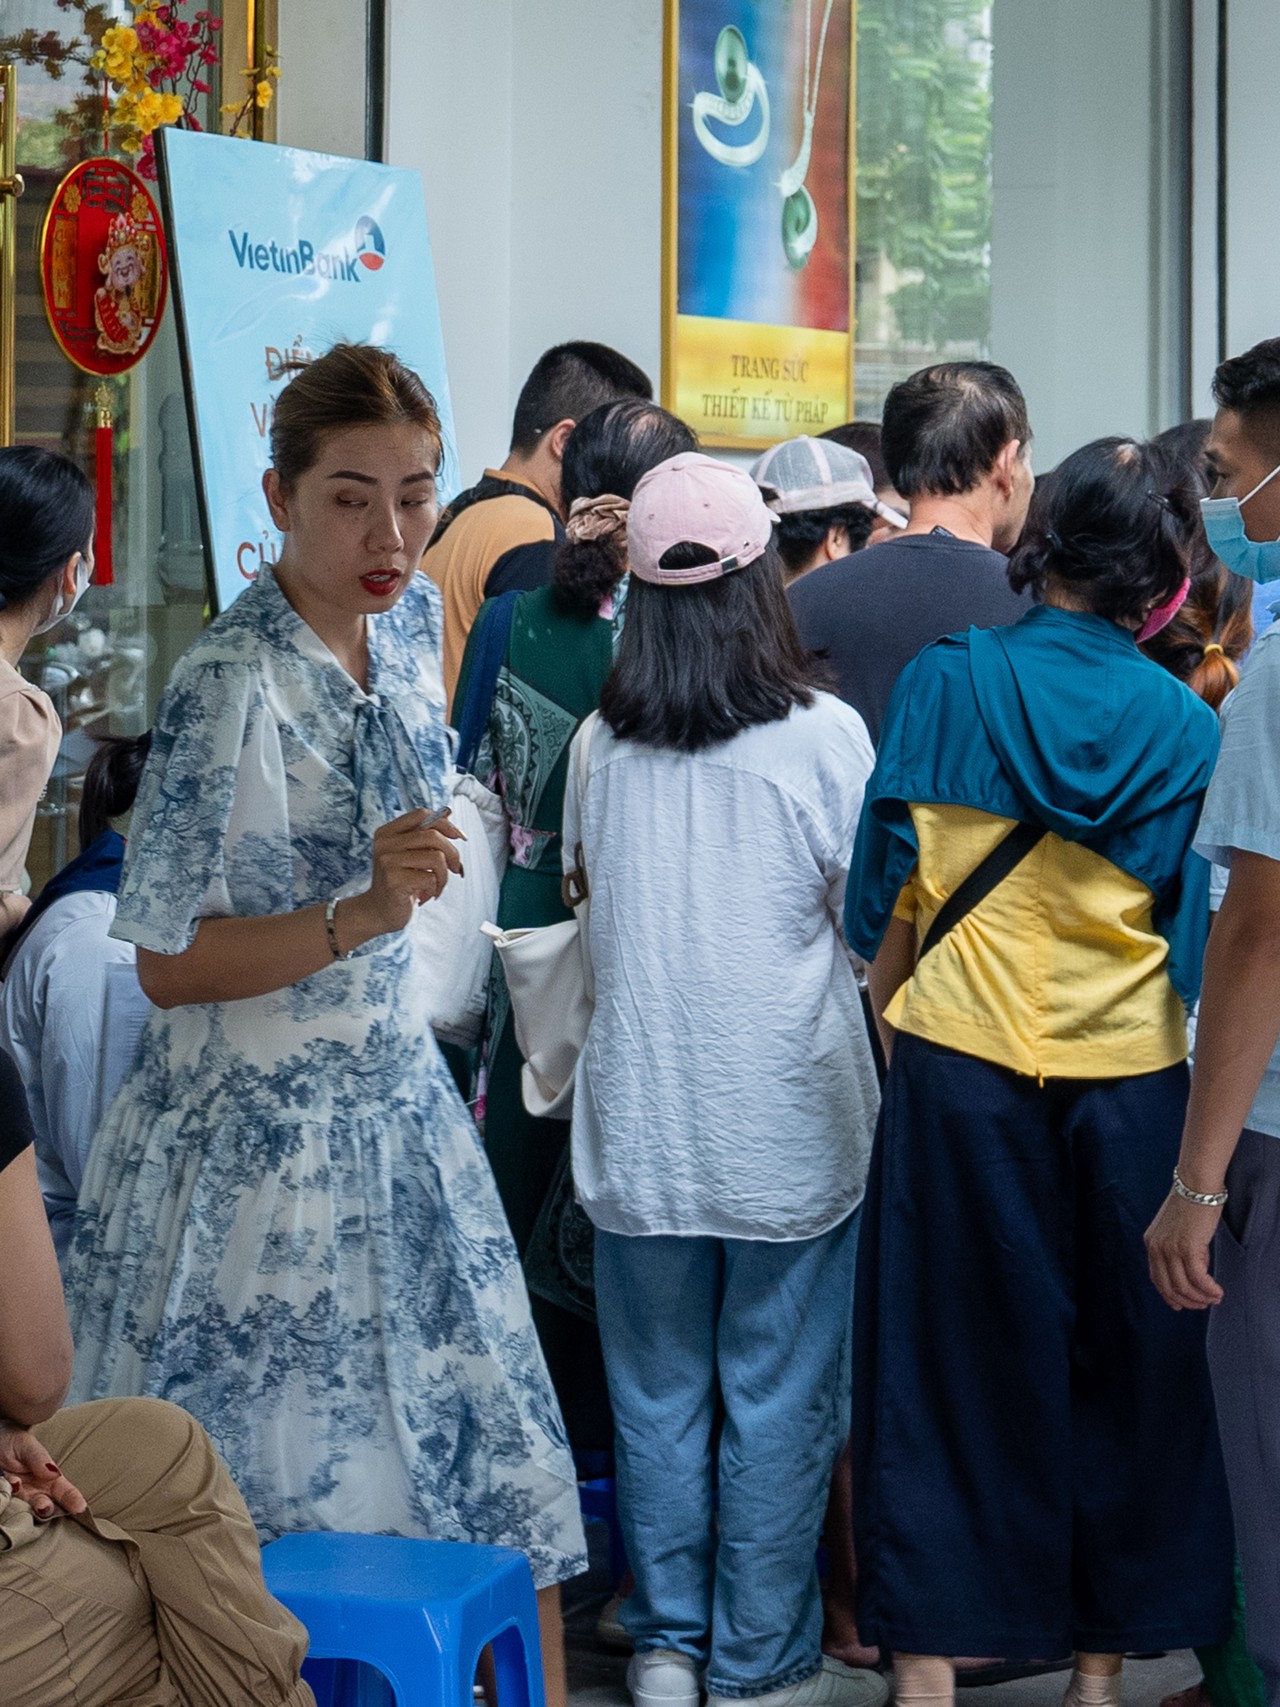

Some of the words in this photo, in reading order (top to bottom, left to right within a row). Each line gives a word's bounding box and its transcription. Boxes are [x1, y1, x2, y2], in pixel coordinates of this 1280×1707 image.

[228, 229, 361, 282] VietinBank
[265, 334, 323, 382] ĐIỂ
[731, 354, 779, 380] TRANG
[782, 352, 809, 384] SỨC
[702, 386, 748, 419] THIẾT
[751, 388, 772, 421] KẾ
[796, 395, 829, 424] PHÁP
